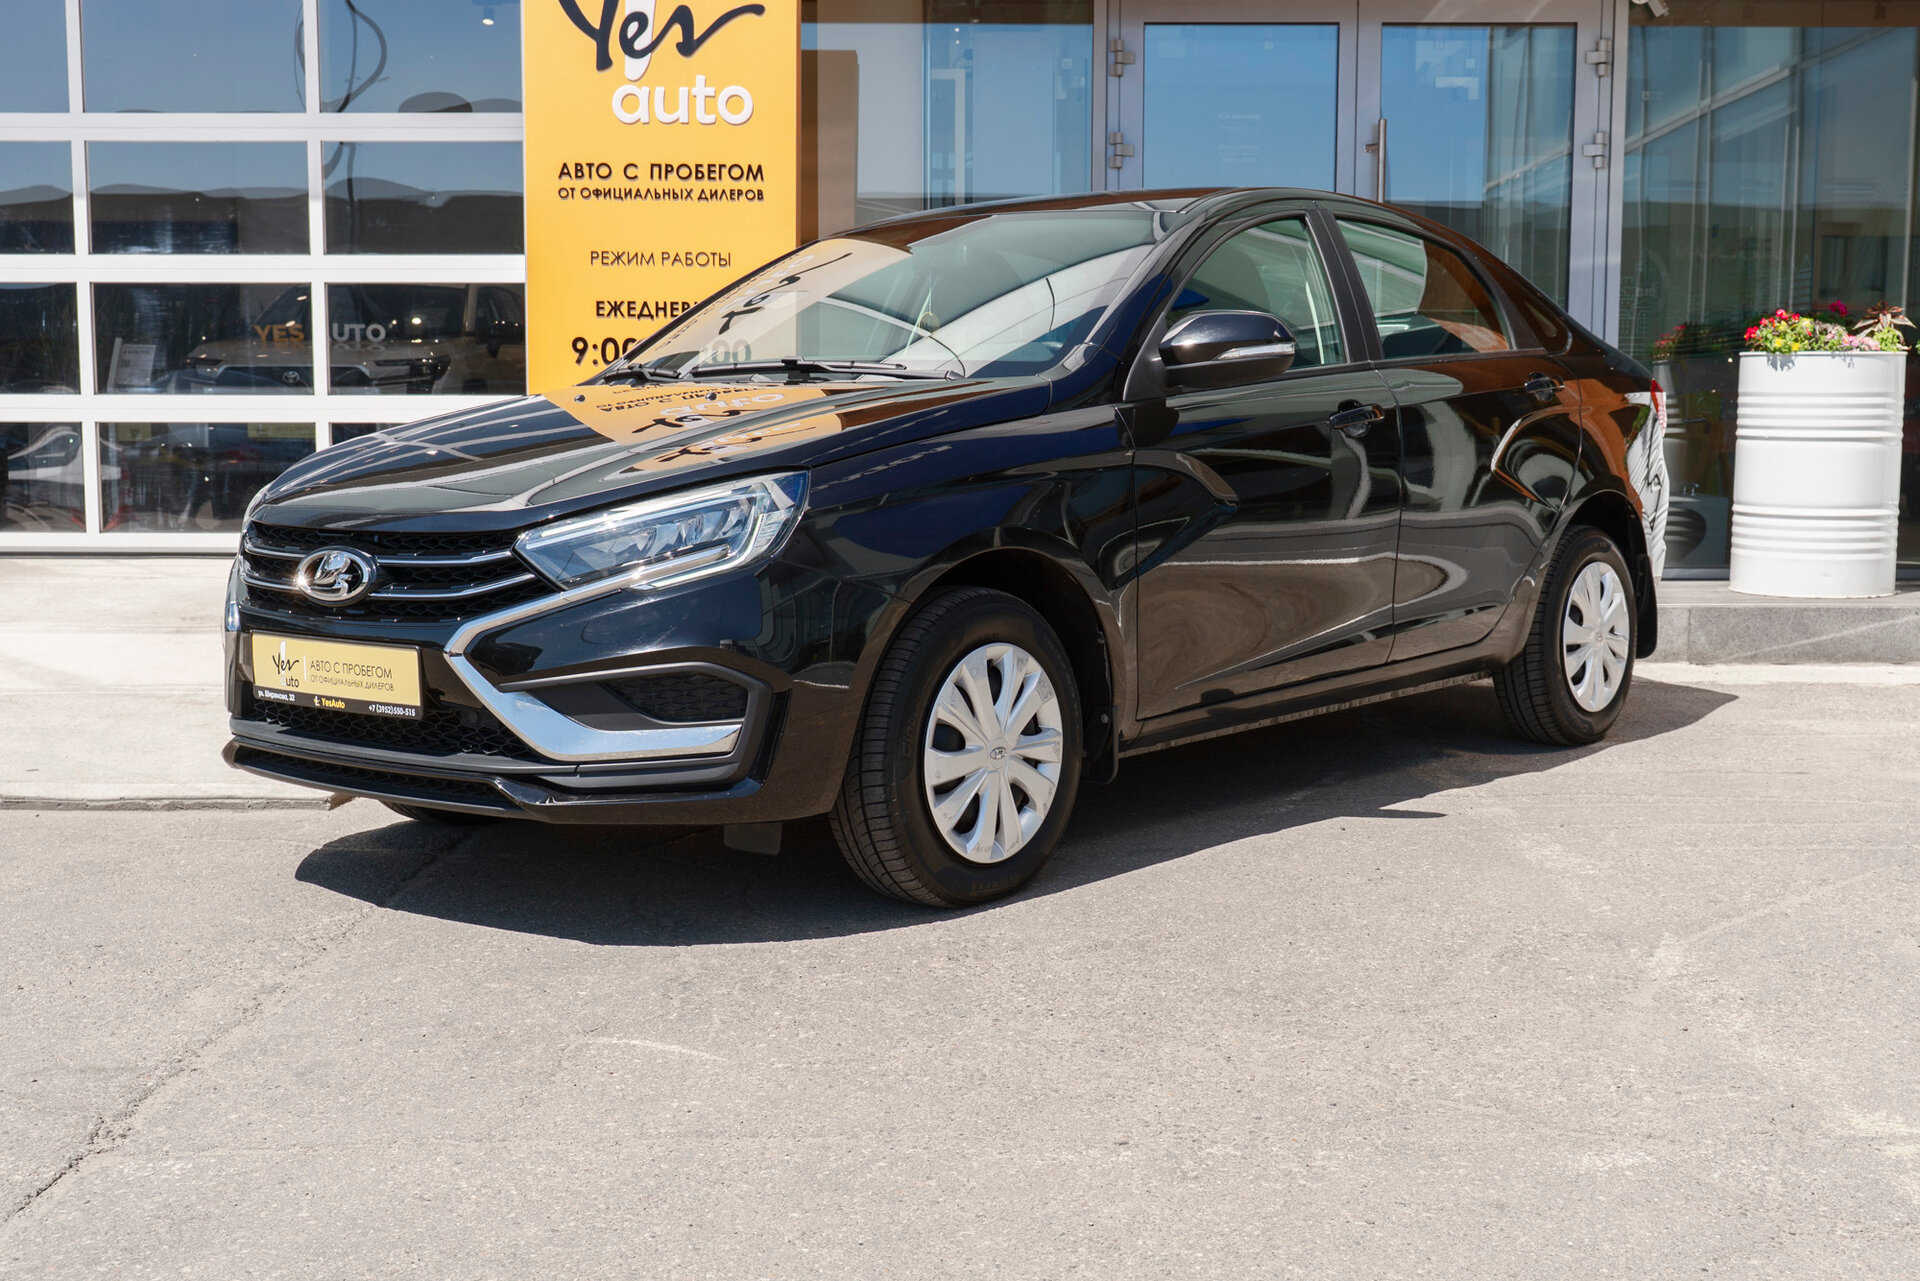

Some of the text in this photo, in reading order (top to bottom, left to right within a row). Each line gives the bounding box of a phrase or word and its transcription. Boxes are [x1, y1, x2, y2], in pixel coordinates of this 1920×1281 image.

[558, 0, 765, 71] Yes
[612, 75, 754, 125] auto
[558, 162, 764, 181] АВТО С ПРОБЕГОМ
[558, 187, 764, 202] ОТ ОФИЦИАЛЬНЫХ ДИЛЕРОВ
[590, 251, 732, 267] РЕЖИМ РАБОТЫ
[254, 322, 386, 342] YES UTO
[272, 652, 299, 675] Yes
[310, 660, 393, 679] АВТО С ПРОБЕГОМ
[310, 675, 395, 692] ОТ ОФИЦИАЛЬНЫХ ДИЛЕРОВ
[321, 697, 346, 709] YesAuto
[368, 704, 376, 713] +7
[393, 706, 416, 717] 550-515
